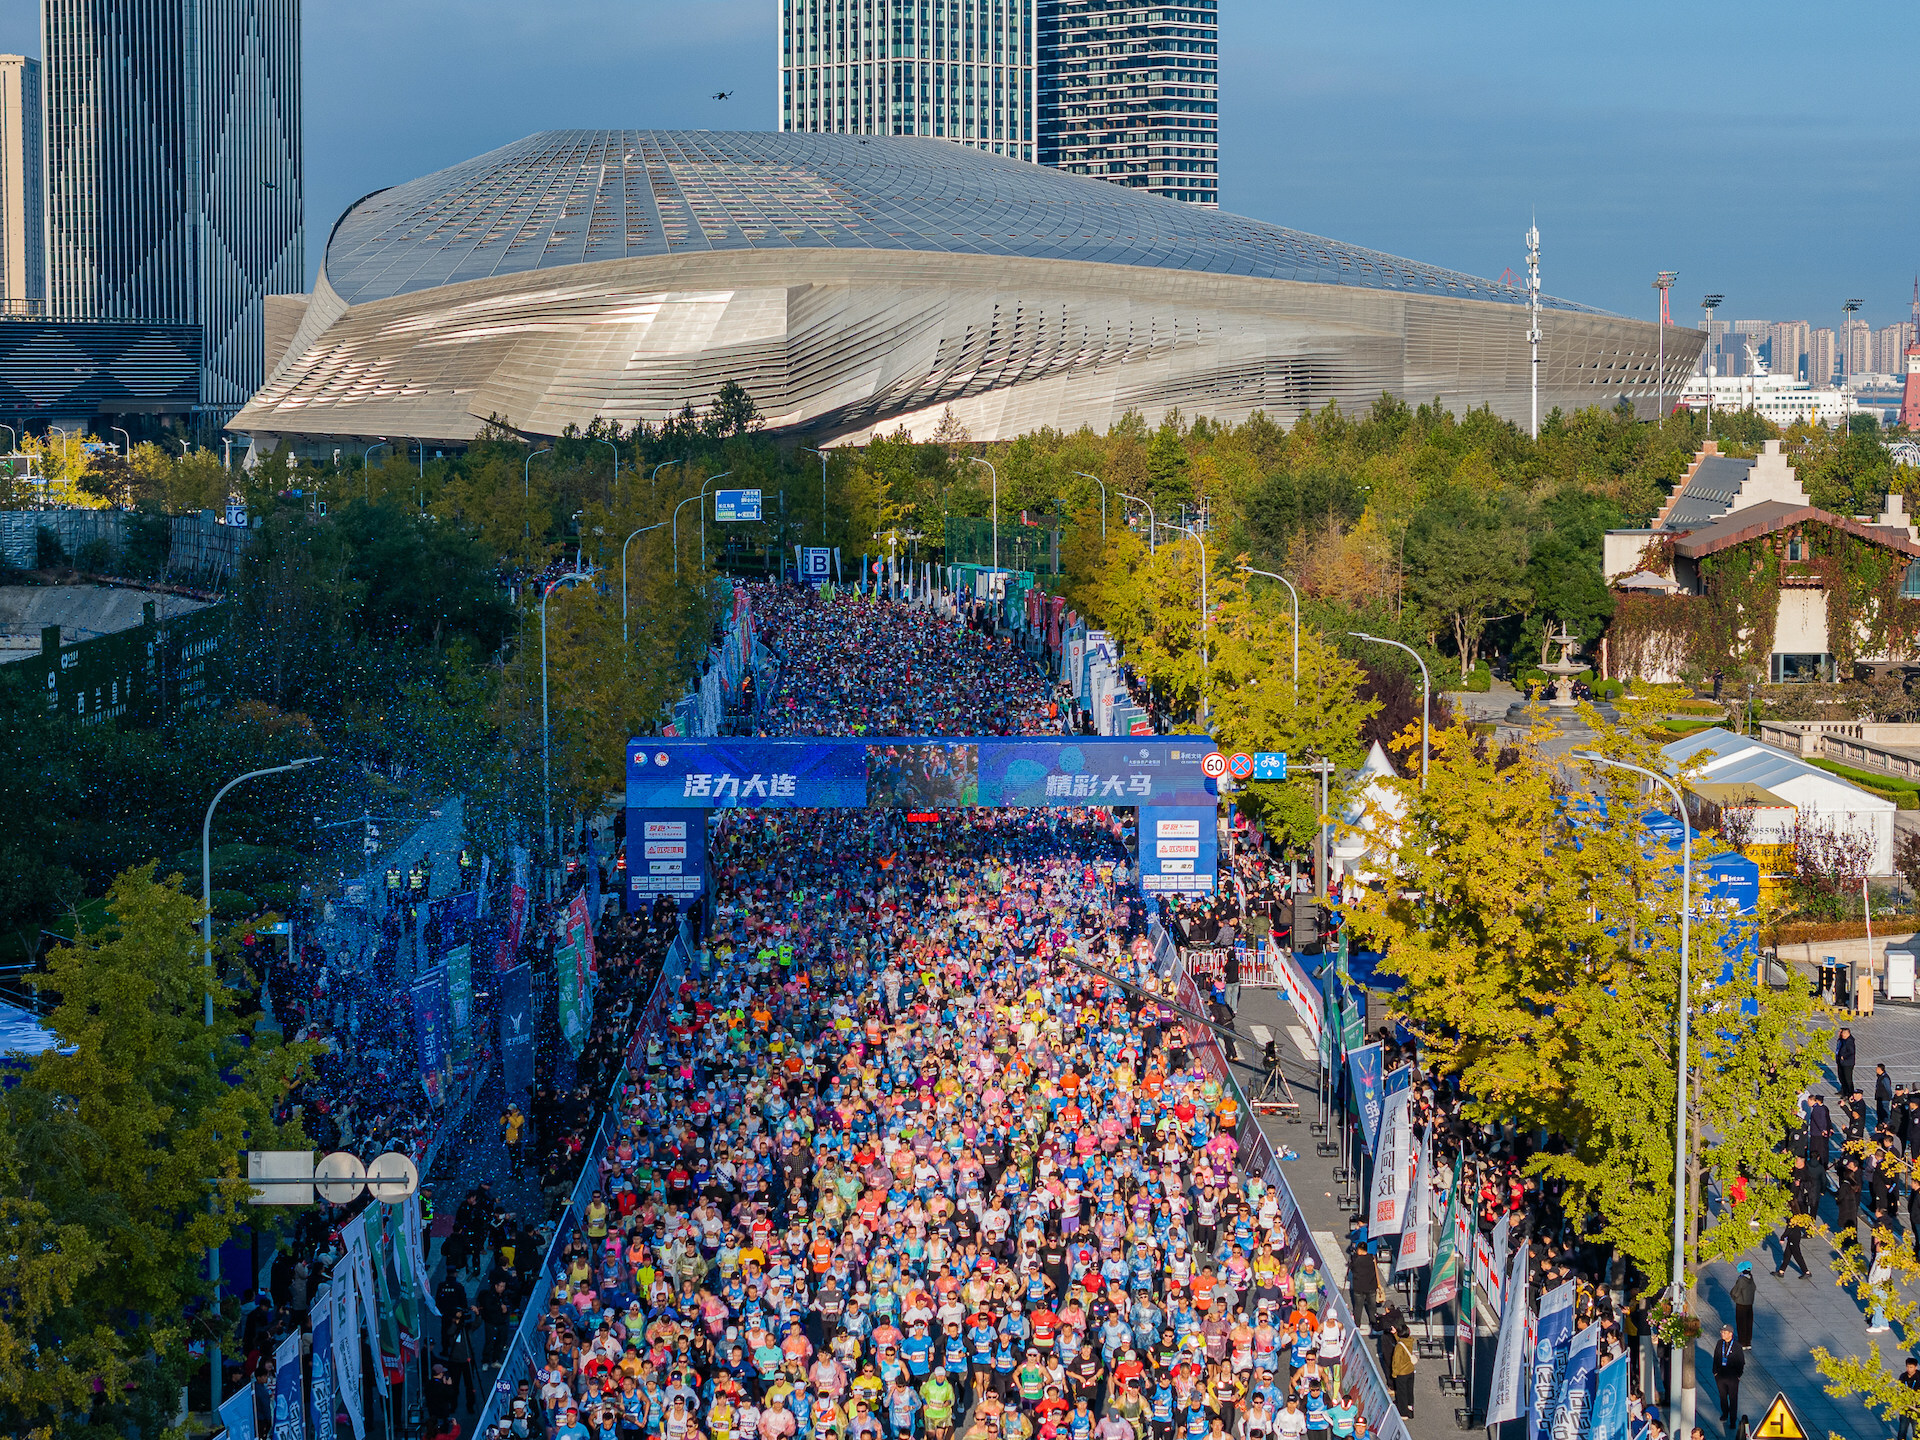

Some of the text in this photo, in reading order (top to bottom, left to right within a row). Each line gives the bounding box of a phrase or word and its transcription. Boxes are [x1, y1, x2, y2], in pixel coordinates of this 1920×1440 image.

[227, 511, 233, 524] C
[235, 511, 245, 524] C
[813, 556, 827, 572] B
[1097, 643, 1112, 664] A
[1206, 759, 1223, 772] 60
[683, 773, 797, 798] 活力大连
[1045, 774, 1152, 797] 精彩大马
[537, 1369, 550, 1381] 6:00
[496, 1382, 510, 1391] 6:00
